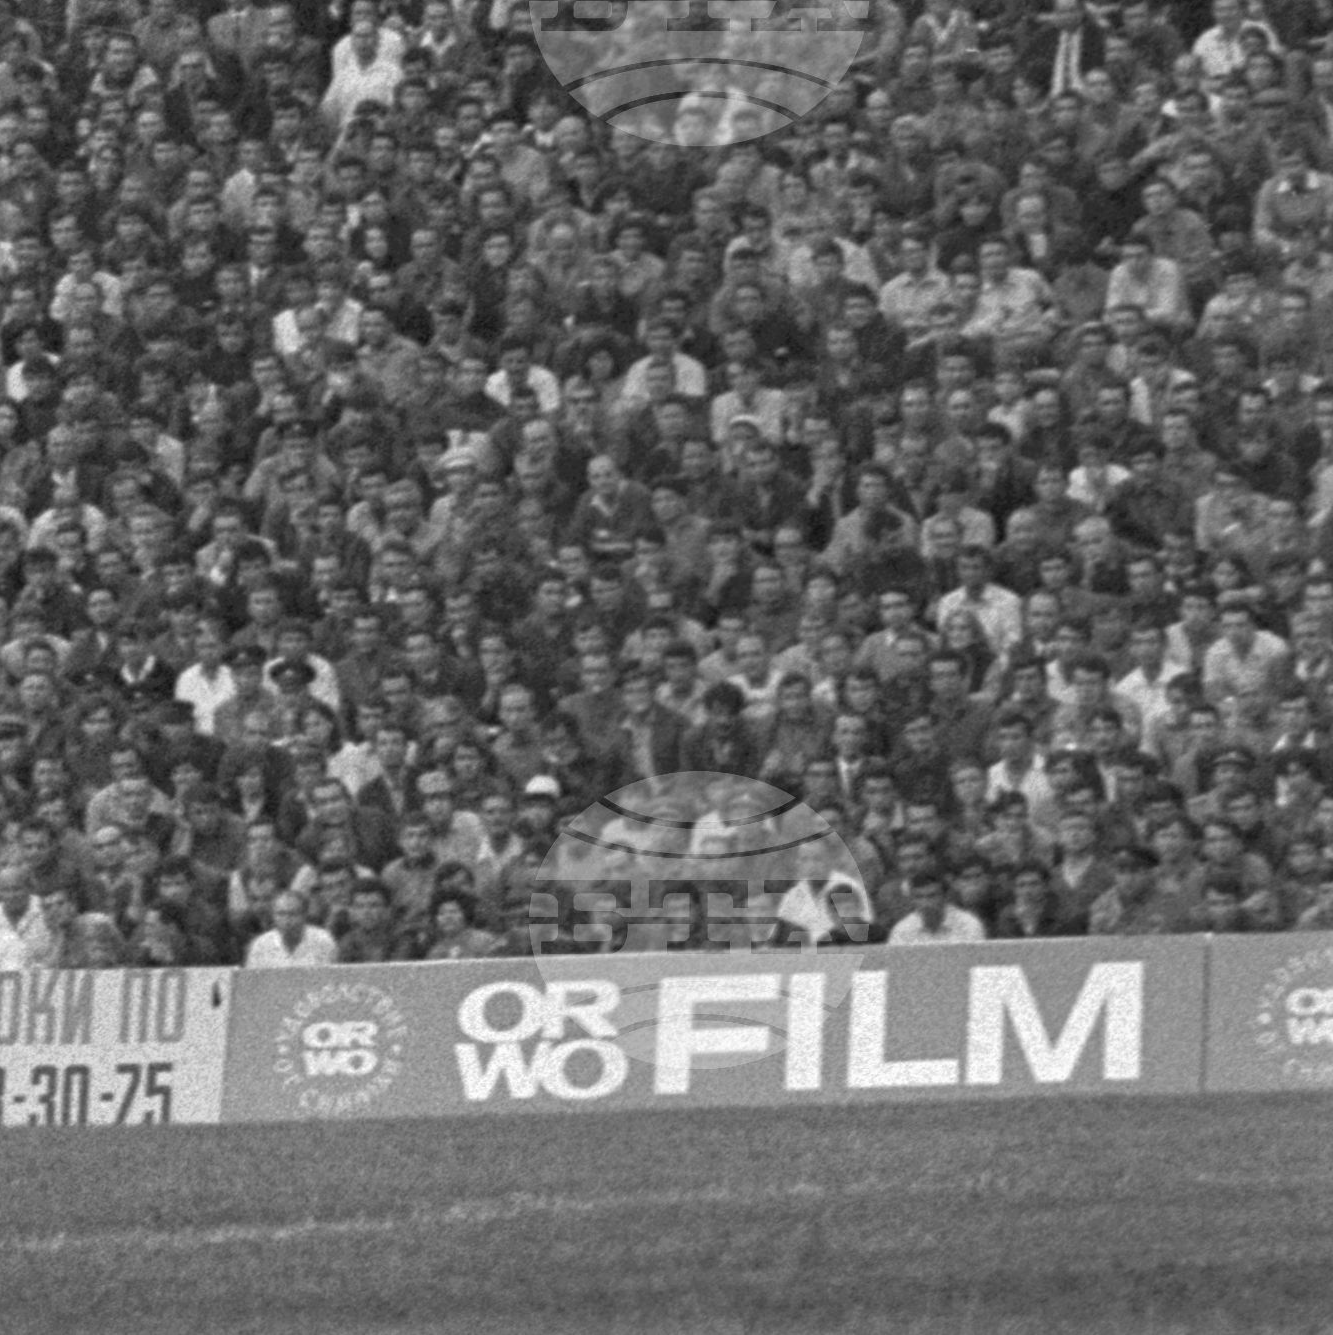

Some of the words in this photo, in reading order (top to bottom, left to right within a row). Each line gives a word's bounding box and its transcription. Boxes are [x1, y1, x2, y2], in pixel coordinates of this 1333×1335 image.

[119, 971, 187, 1045] ПО
[302, 1021, 379, 1047] OR
[457, 980, 622, 1040] OR
[652, 961, 1145, 1096] FILM
[1286, 1017, 1333, 1045] W
[302, 1049, 379, 1076] WO
[454, 1039, 629, 1102] WO
